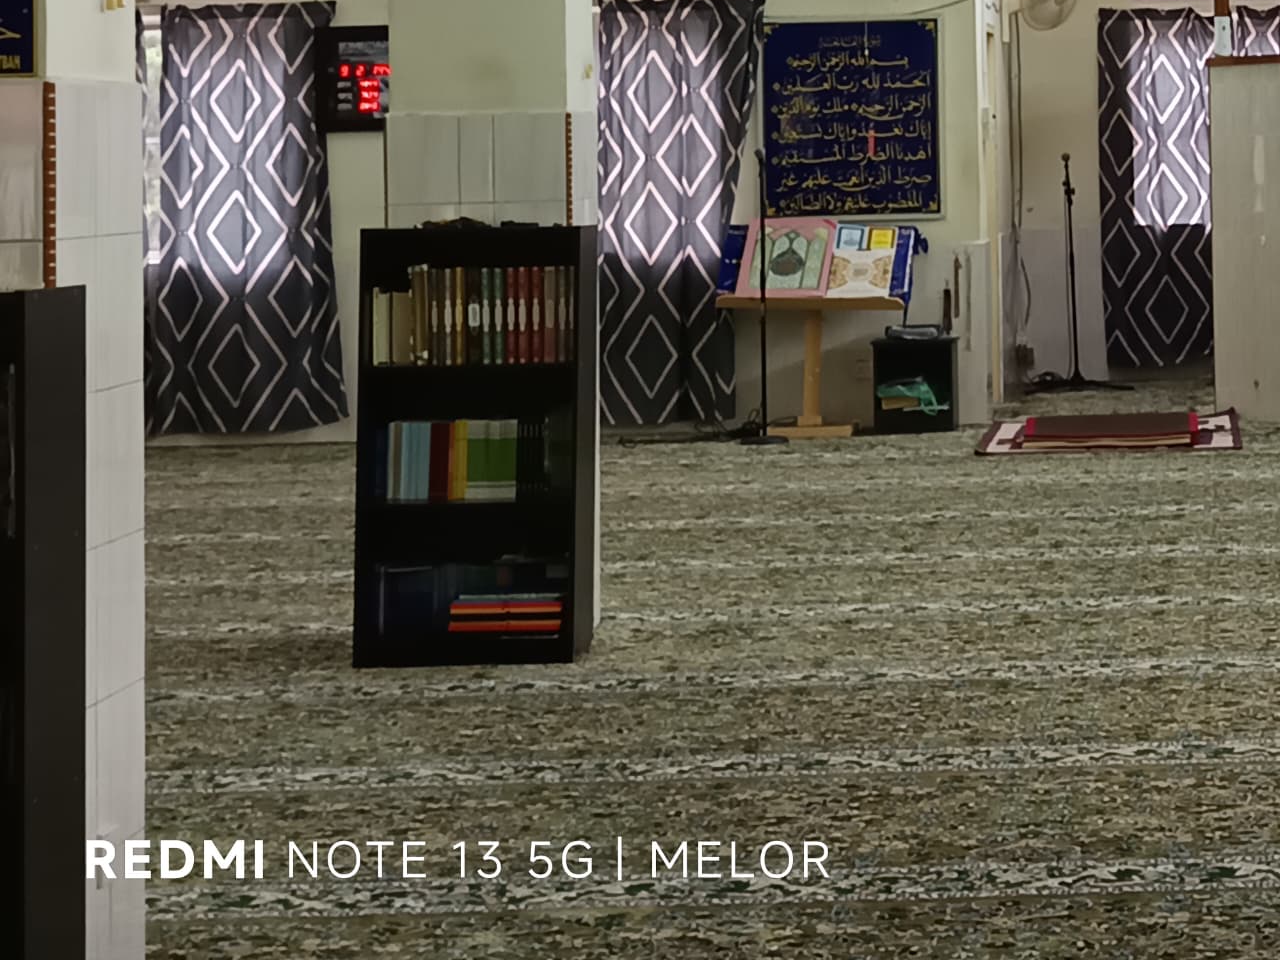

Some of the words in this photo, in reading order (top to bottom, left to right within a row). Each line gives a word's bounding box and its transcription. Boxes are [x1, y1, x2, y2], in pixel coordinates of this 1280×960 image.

[869, 54, 910, 70] بسم
[862, 70, 881, 89] لله
[883, 69, 932, 88] الحمد
